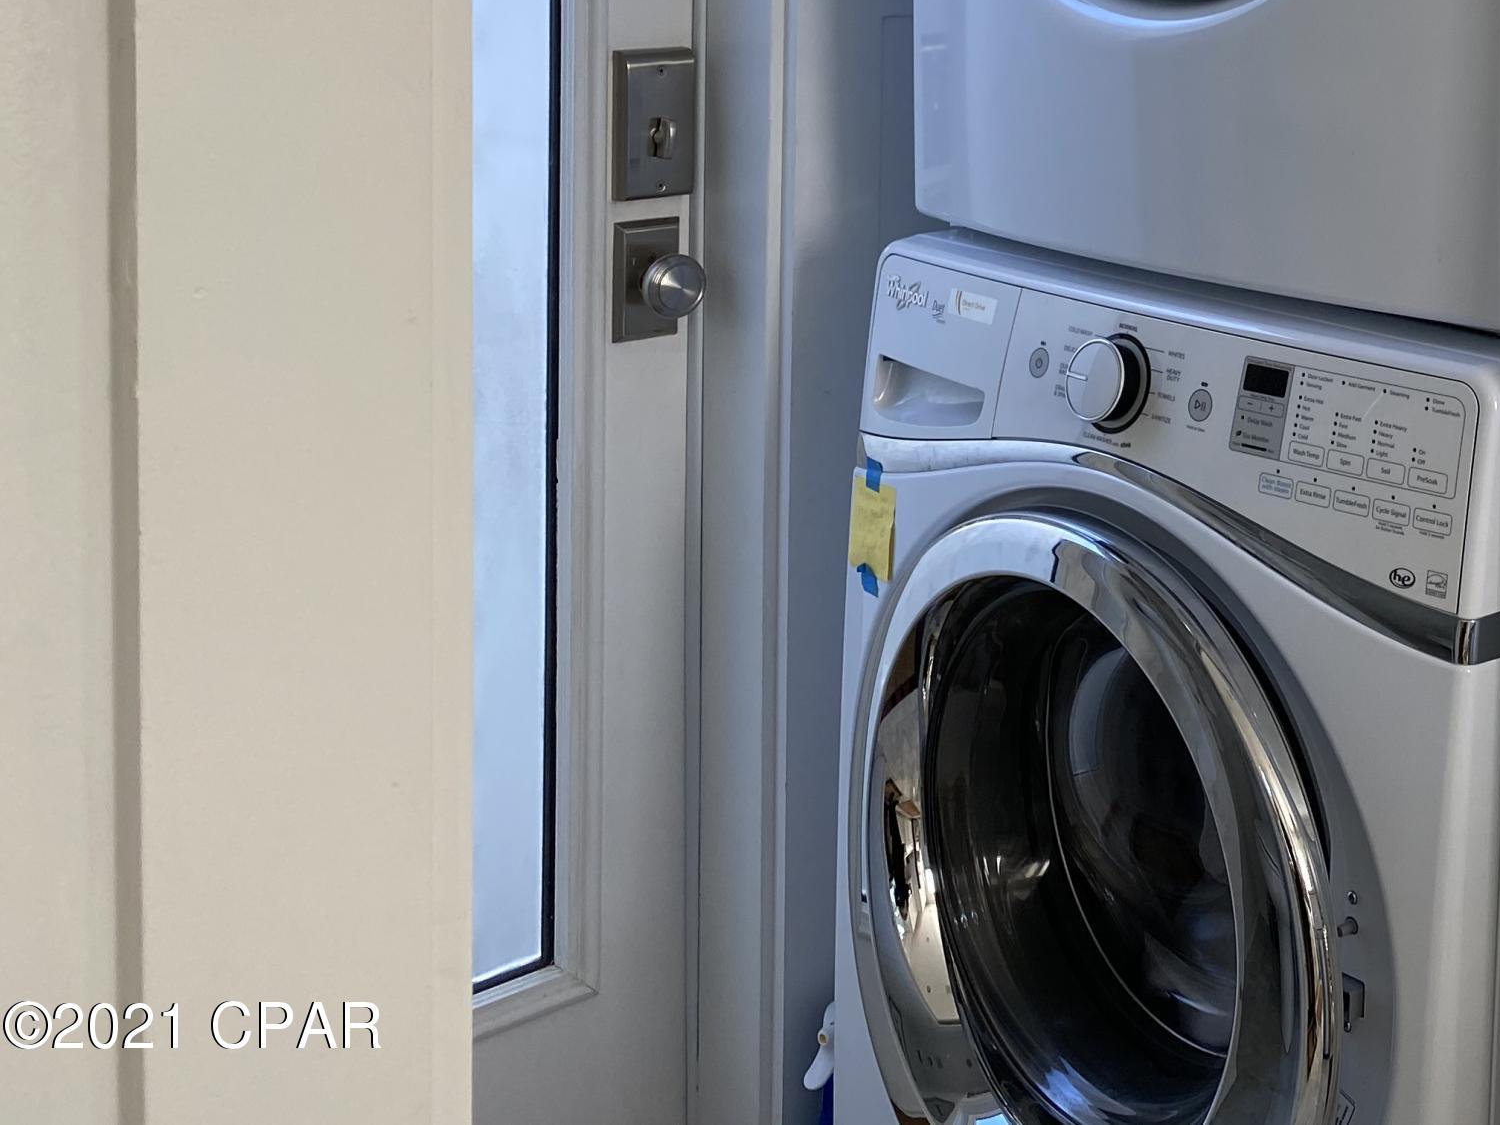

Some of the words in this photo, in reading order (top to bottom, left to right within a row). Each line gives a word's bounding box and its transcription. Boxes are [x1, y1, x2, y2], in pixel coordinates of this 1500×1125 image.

[887, 277, 930, 310] Whirlpool
[1293, 448, 1307, 456] Wash
[1306, 450, 1321, 460] Temp
[1339, 458, 1351, 467] Spin
[1380, 467, 1391, 475] Soil
[1416, 475, 1438, 486] PreSoak
[1300, 488, 1312, 497] Extra
[1313, 492, 1326, 500] Rinse
[1336, 497, 1368, 510] TumbleFresh
[1375, 506, 1389, 516] Cycle
[1390, 509, 1407, 520] Signal
[1416, 514, 1436, 525] Control
[1436, 519, 1449, 528] Lock
